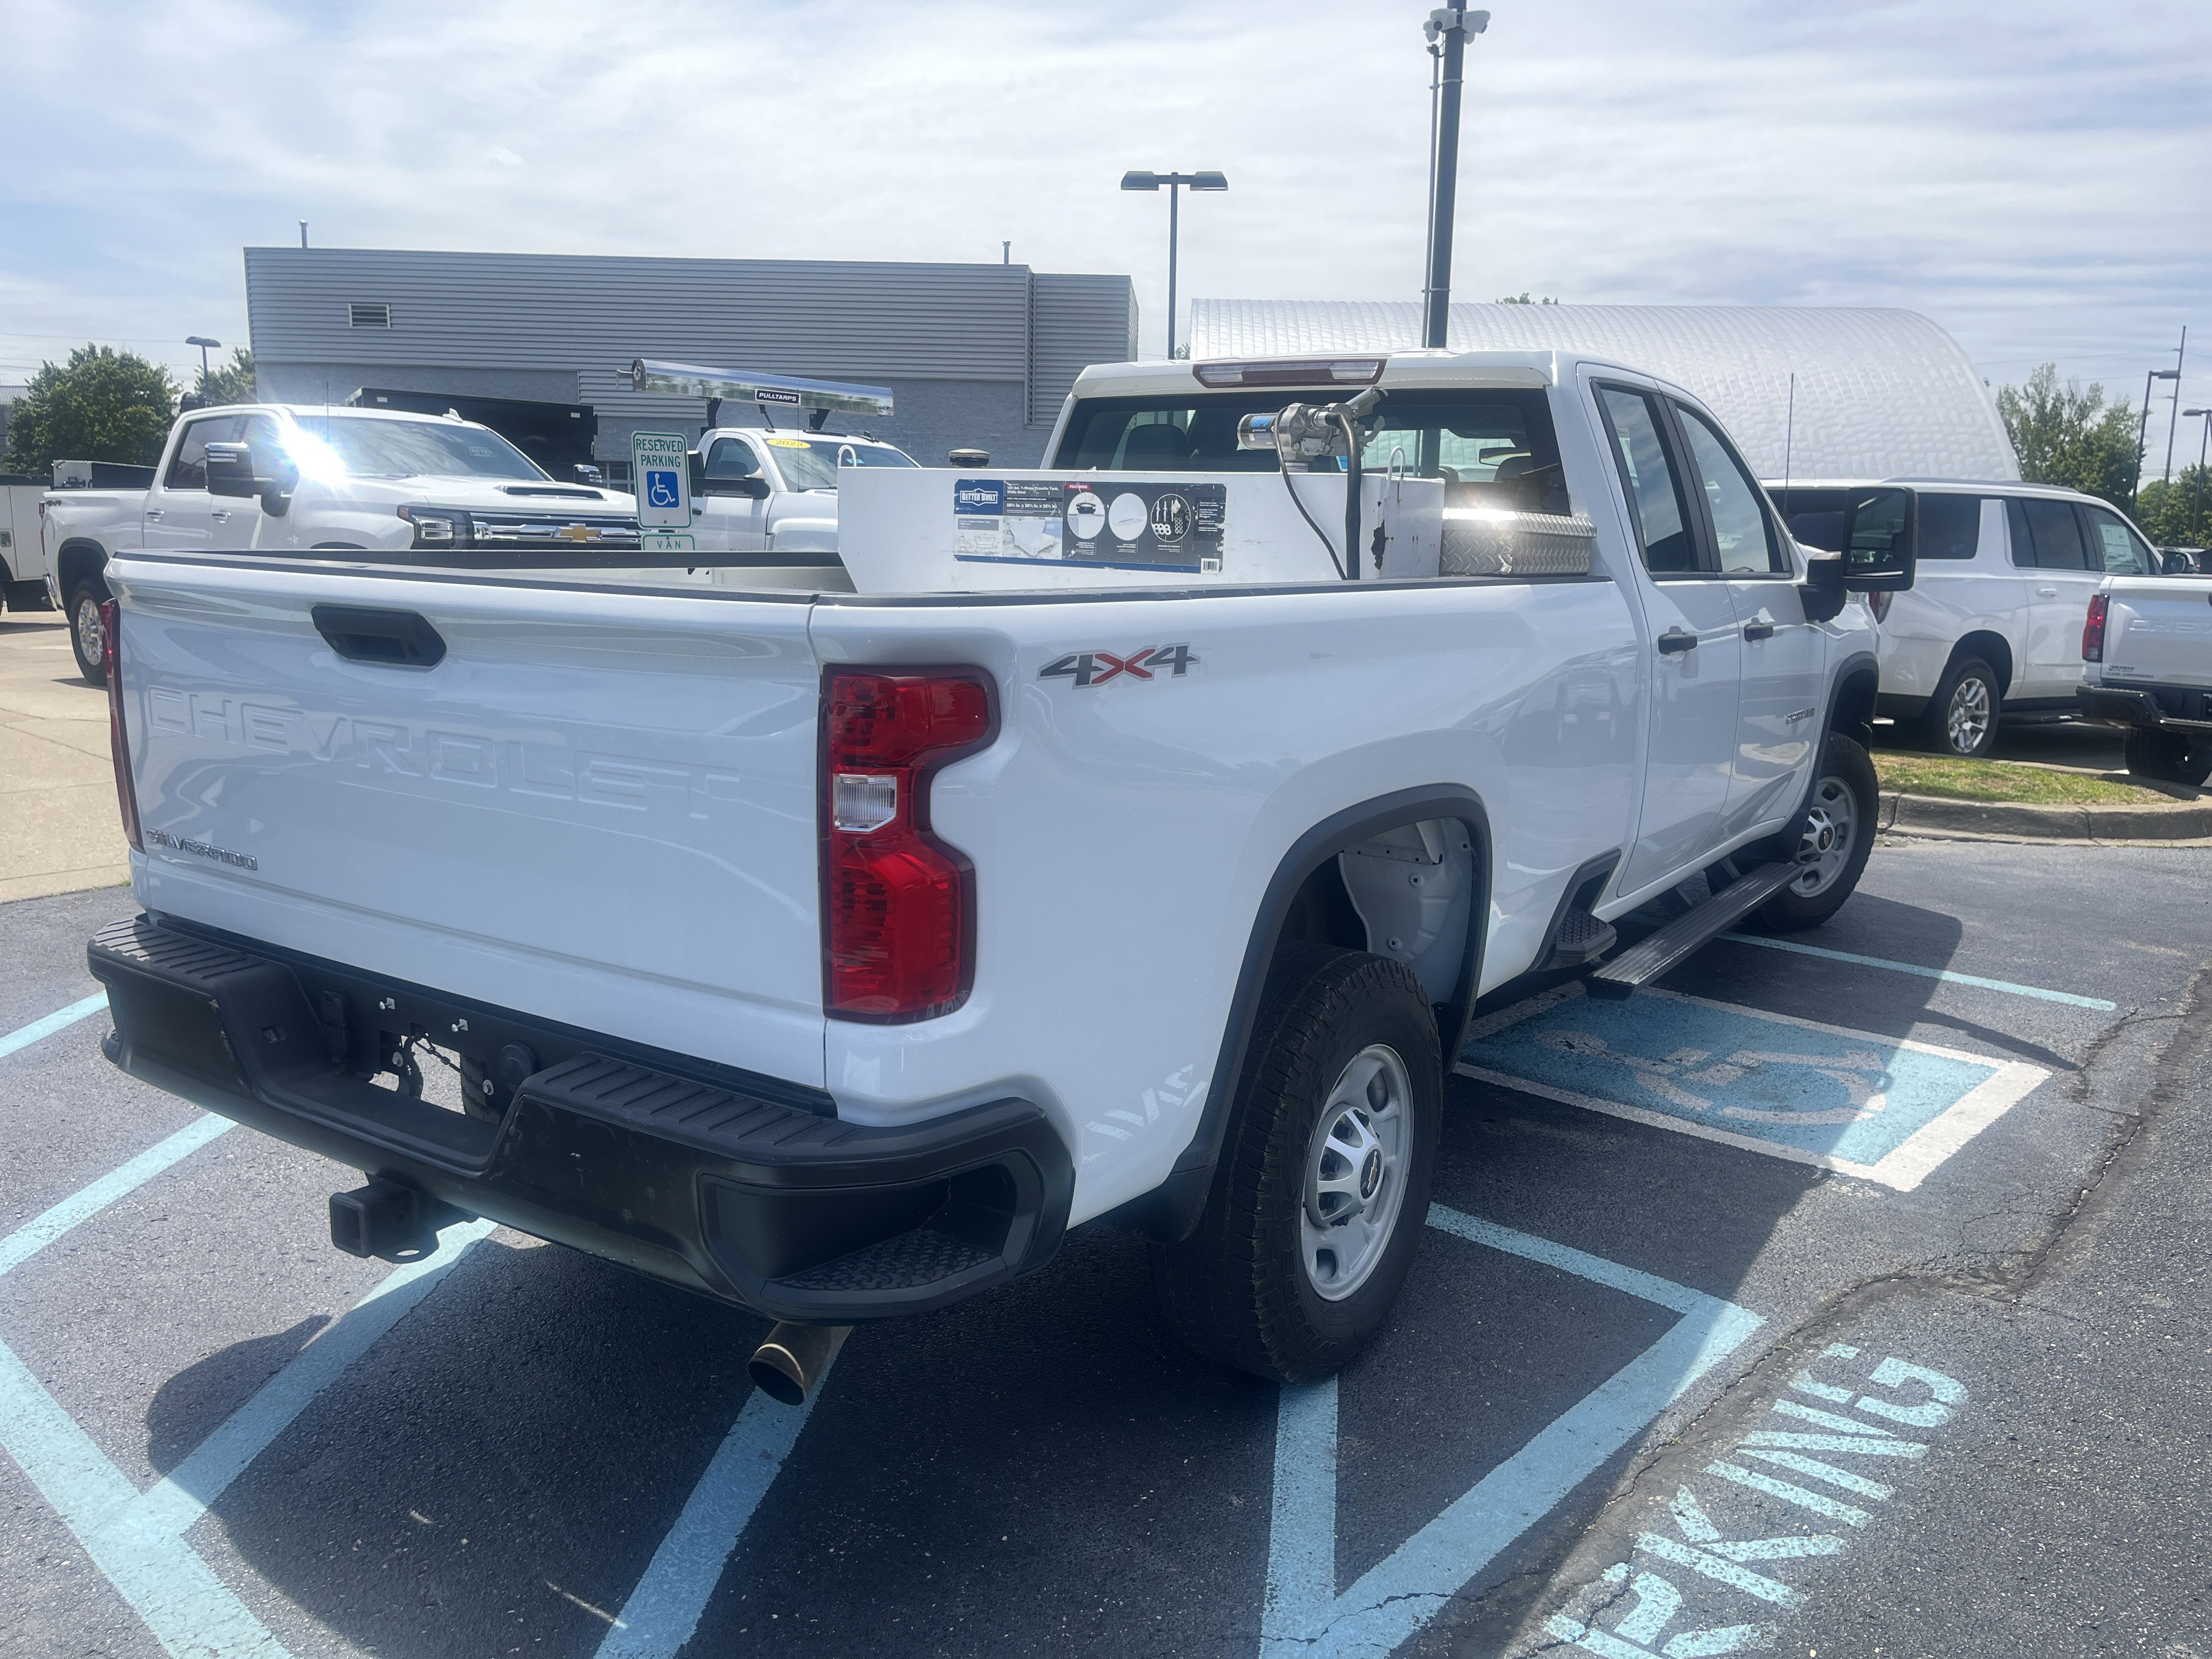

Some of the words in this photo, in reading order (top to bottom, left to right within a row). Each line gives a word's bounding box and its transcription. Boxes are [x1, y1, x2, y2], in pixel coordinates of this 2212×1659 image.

[759, 392, 797, 401] PULLTARPS
[635, 438, 683, 452] RESERVED
[640, 454, 681, 467] PARKING
[961, 492, 980, 501] BETTER
[981, 493, 996, 501] BUILT
[657, 540, 681, 549] VAN
[148, 685, 741, 819] CHEVROLET
[146, 827, 258, 871] SILVERADO
